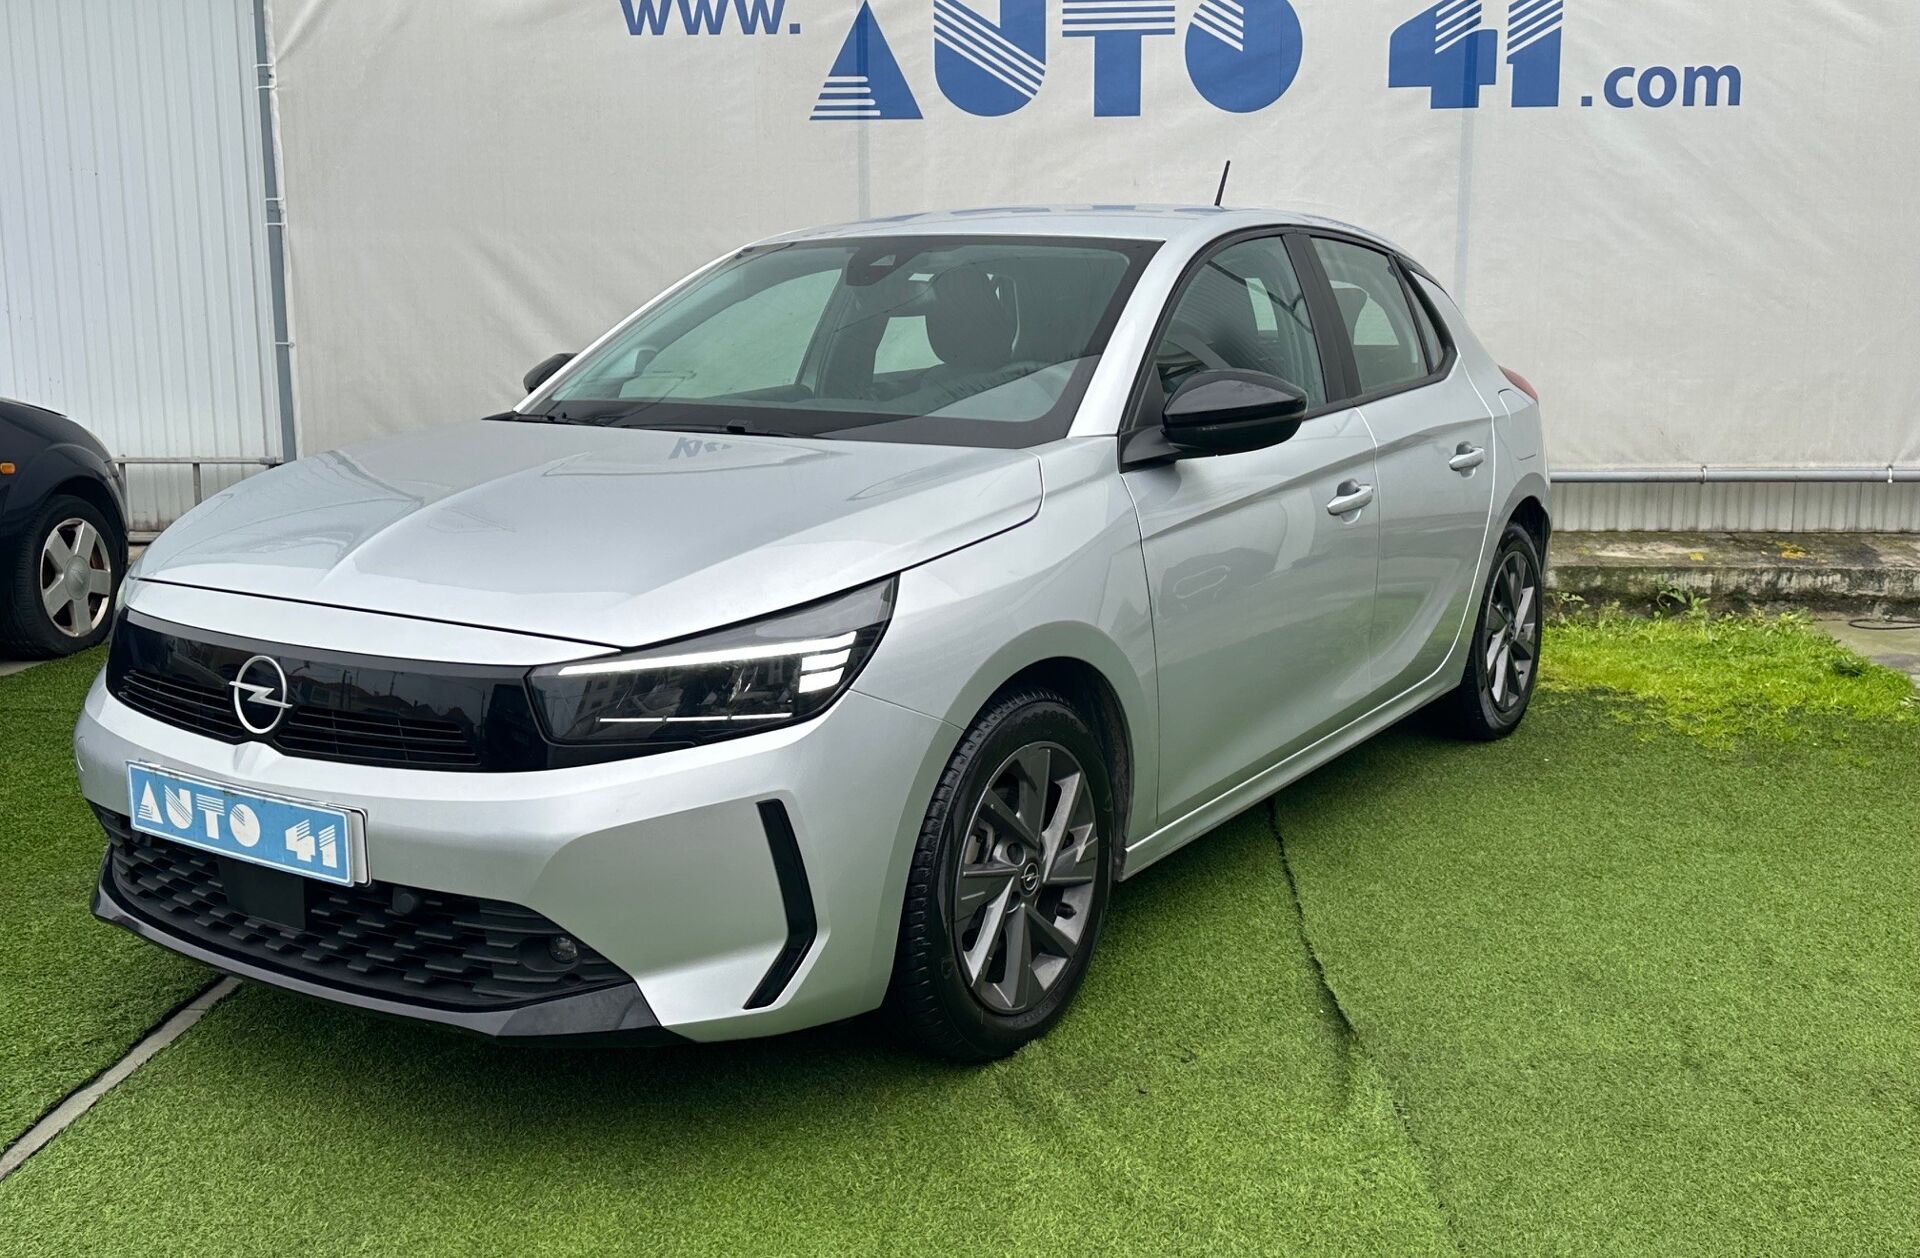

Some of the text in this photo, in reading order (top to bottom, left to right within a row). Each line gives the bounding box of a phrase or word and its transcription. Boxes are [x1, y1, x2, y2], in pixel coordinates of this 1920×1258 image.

[620, 0, 1742, 120] www. AUTO 41 .com
[137, 780, 338, 869] AUTO 41
